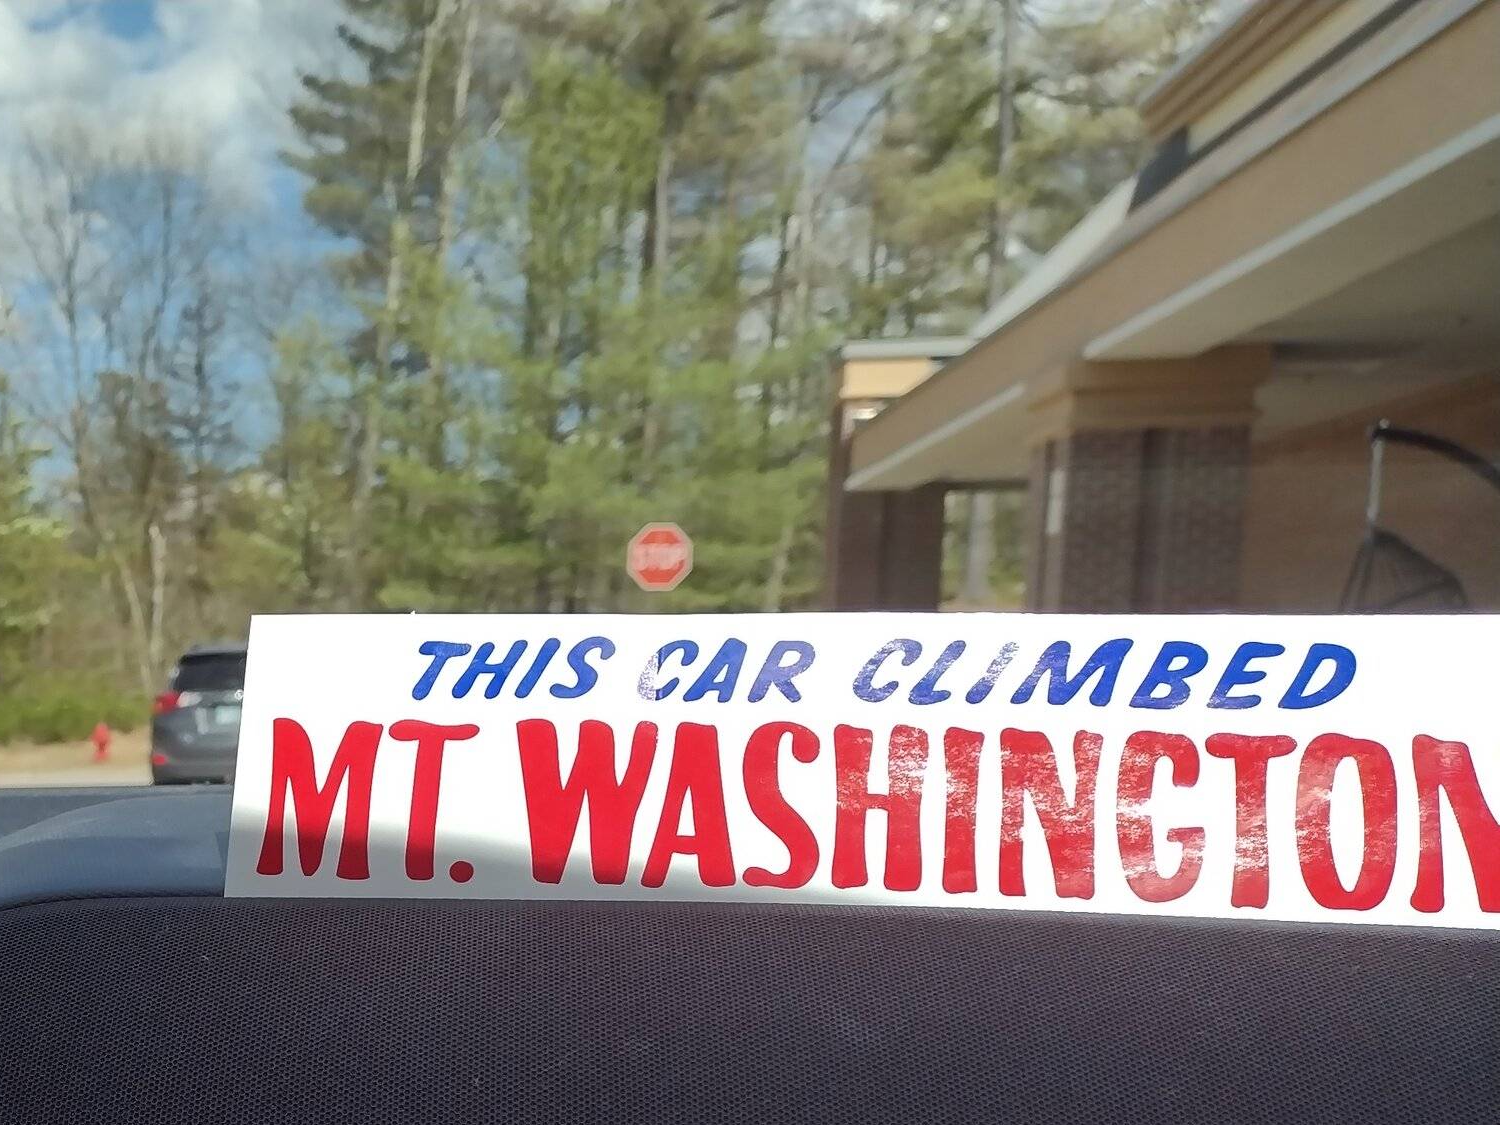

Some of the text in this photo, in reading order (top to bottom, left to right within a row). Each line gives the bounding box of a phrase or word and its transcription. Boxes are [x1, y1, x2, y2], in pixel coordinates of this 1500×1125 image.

[412, 637, 1359, 712] THIS CAR CLIMBED
[255, 716, 1500, 915] MT. WASHINGTON
